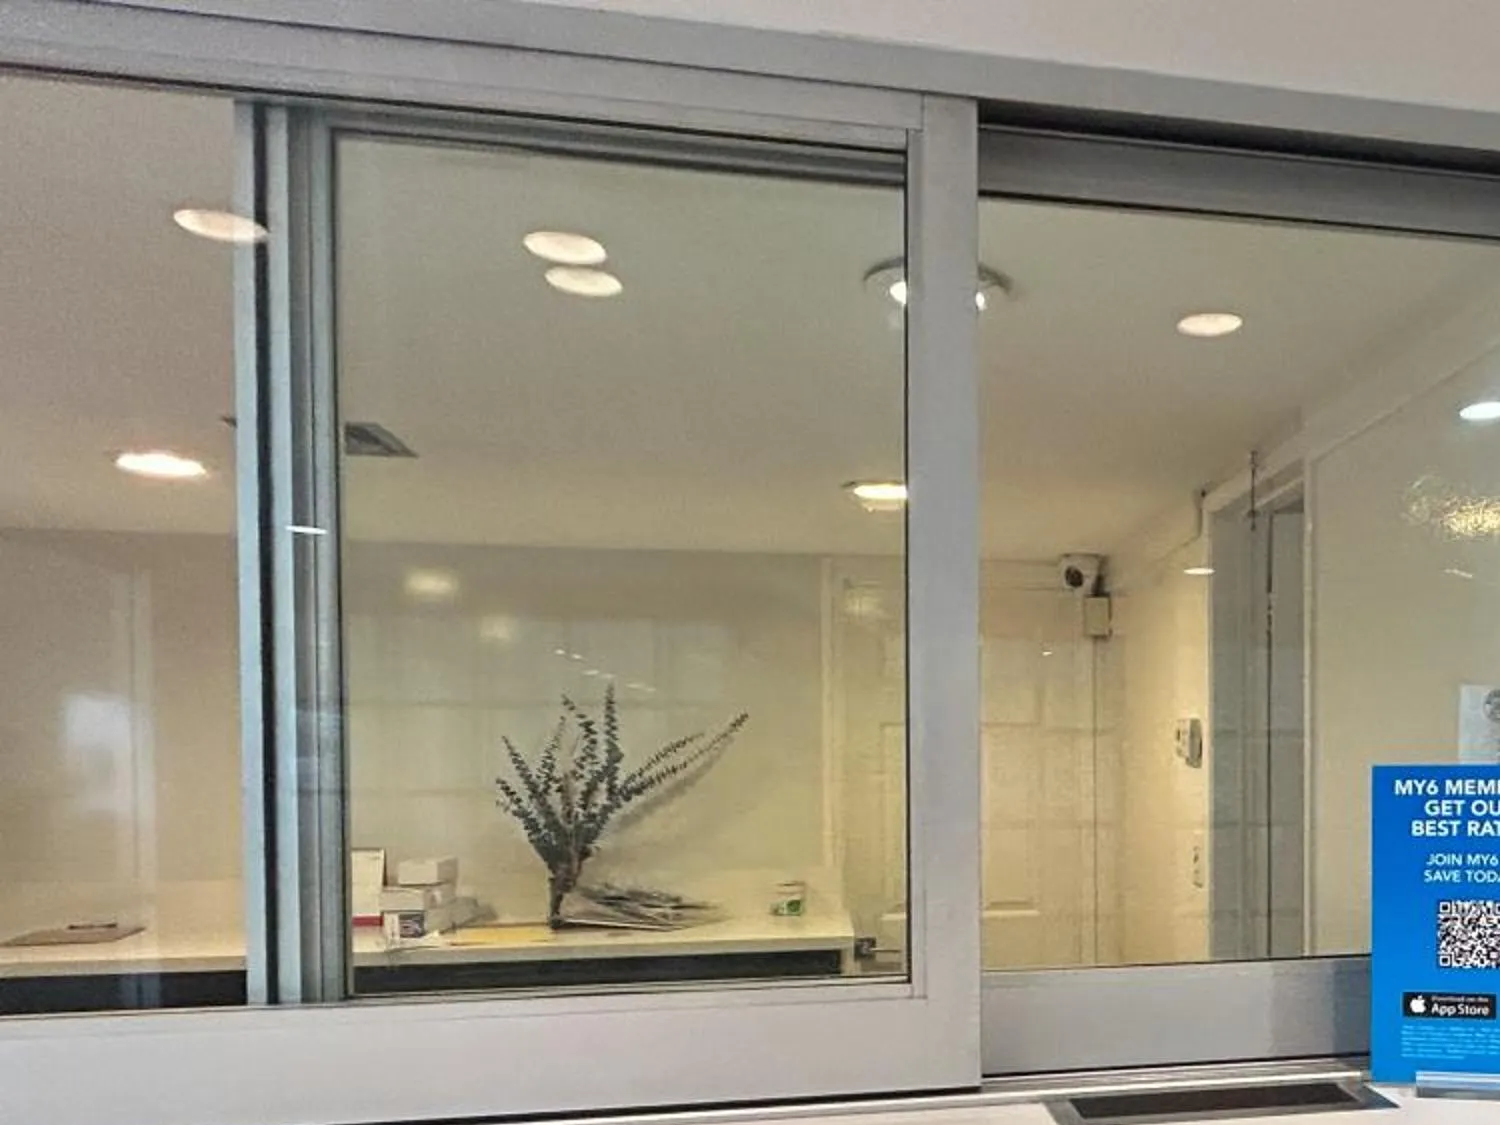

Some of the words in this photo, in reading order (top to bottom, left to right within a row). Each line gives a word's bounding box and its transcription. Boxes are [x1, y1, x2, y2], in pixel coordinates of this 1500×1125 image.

[1395, 779, 1438, 796] MY6
[1424, 799, 1464, 817] GET
[1411, 820, 1459, 837] BEST
[1426, 854, 1463, 867] JOIN
[1467, 854, 1499, 867] MY6
[1424, 870, 1460, 883] SAVE
[1431, 1003, 1456, 1015] App
[1457, 1003, 1490, 1016] Store
